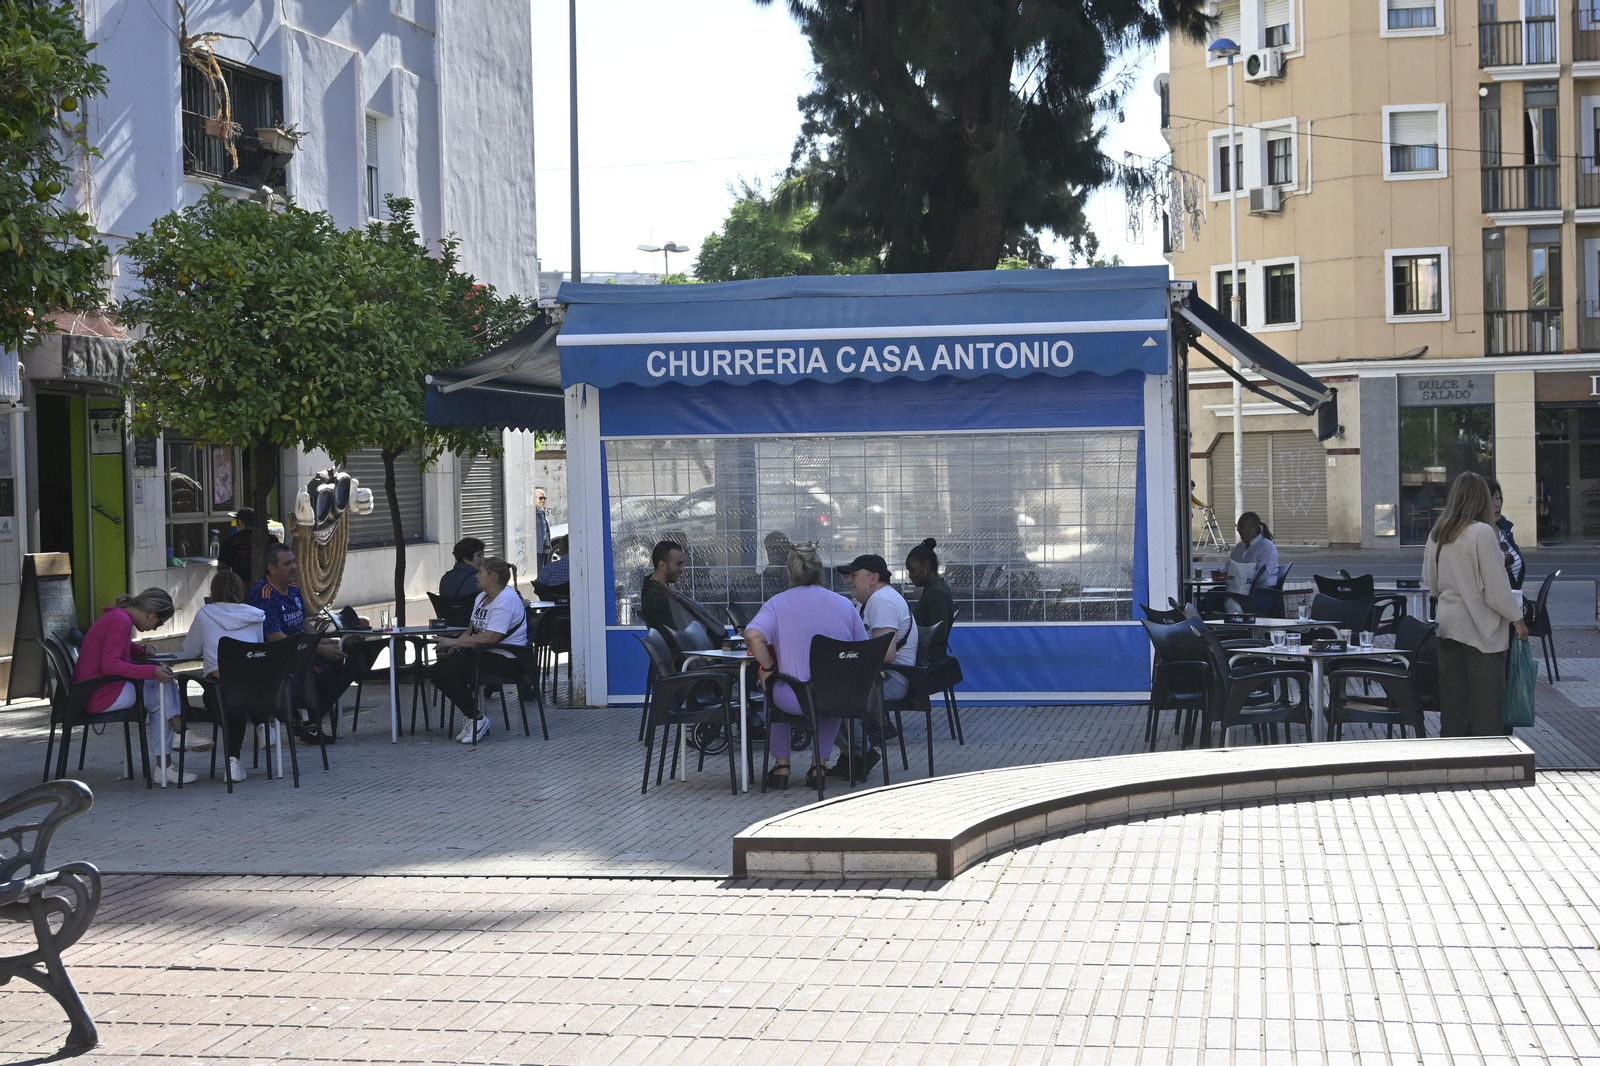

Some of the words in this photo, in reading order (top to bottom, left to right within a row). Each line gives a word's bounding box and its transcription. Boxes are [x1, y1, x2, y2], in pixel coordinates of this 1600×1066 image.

[646, 347, 829, 378] CHURRERIA
[836, 345, 926, 374] CASA
[930, 340, 1075, 371] ANTONIO
[1418, 380, 1459, 390] DULCE
[1467, 380, 1474, 388] &
[1422, 390, 1471, 400] SALADO
